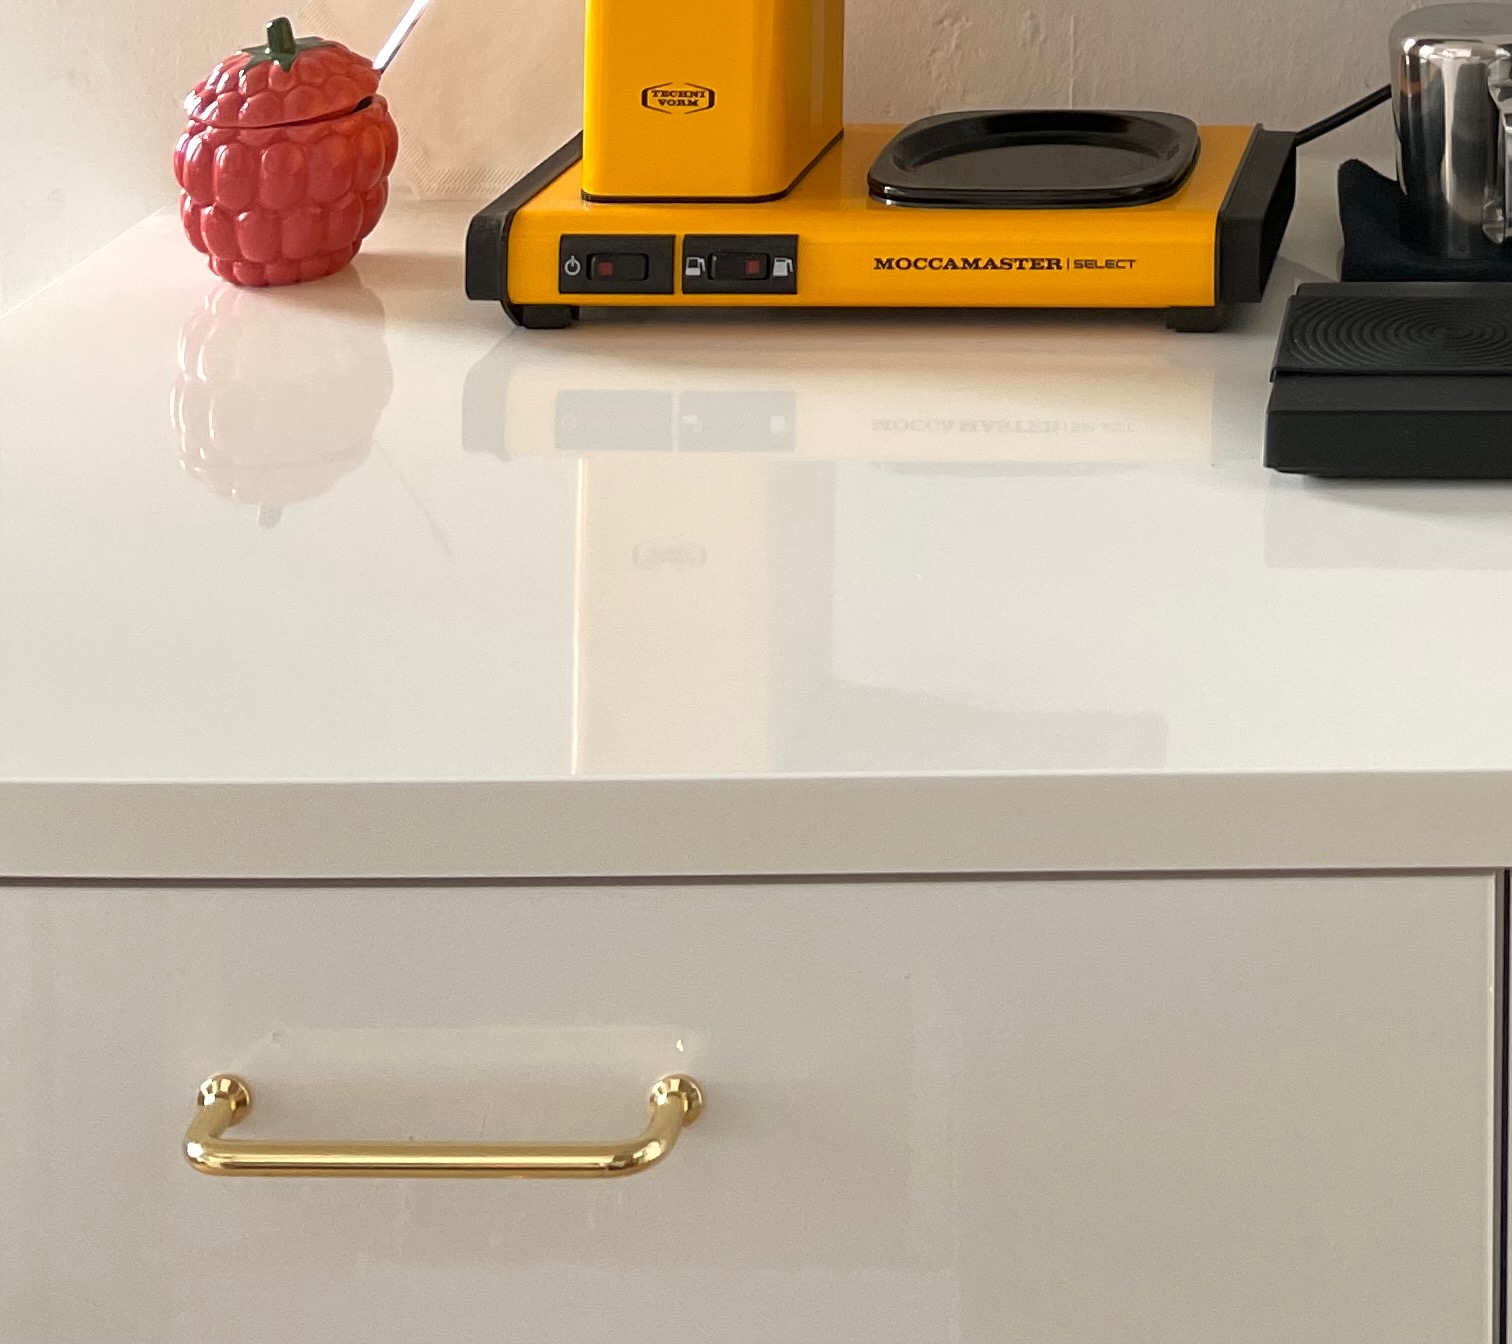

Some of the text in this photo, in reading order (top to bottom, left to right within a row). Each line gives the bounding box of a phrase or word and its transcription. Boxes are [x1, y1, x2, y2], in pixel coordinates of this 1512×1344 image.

[651, 90, 705, 98] TECHNI
[874, 257, 1136, 270] MOCCAMASTER SELECT
